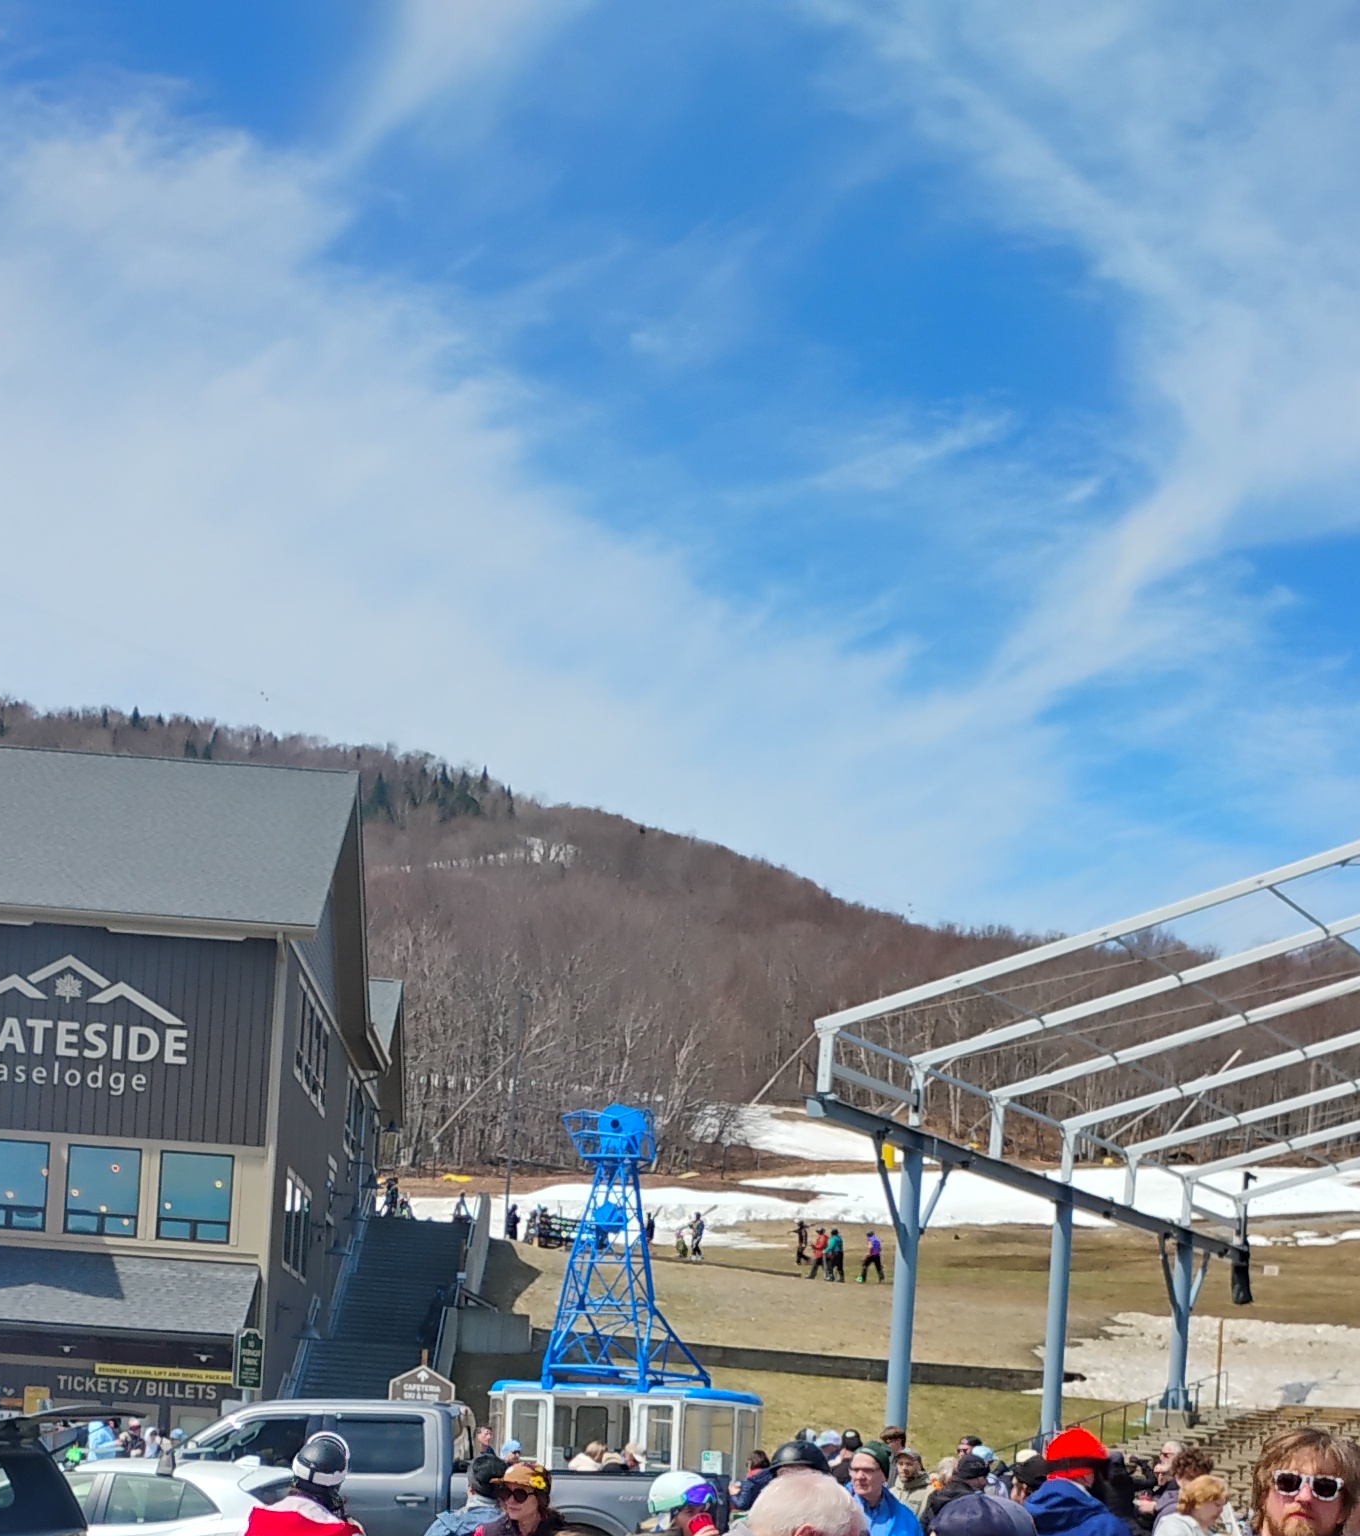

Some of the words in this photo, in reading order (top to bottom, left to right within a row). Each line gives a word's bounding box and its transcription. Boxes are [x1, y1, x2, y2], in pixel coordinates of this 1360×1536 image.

[57, 1375, 128, 1394] TICKETS
[145, 1381, 217, 1399] BILLETS
[403, 1384, 441, 1392] CAFETERIA
